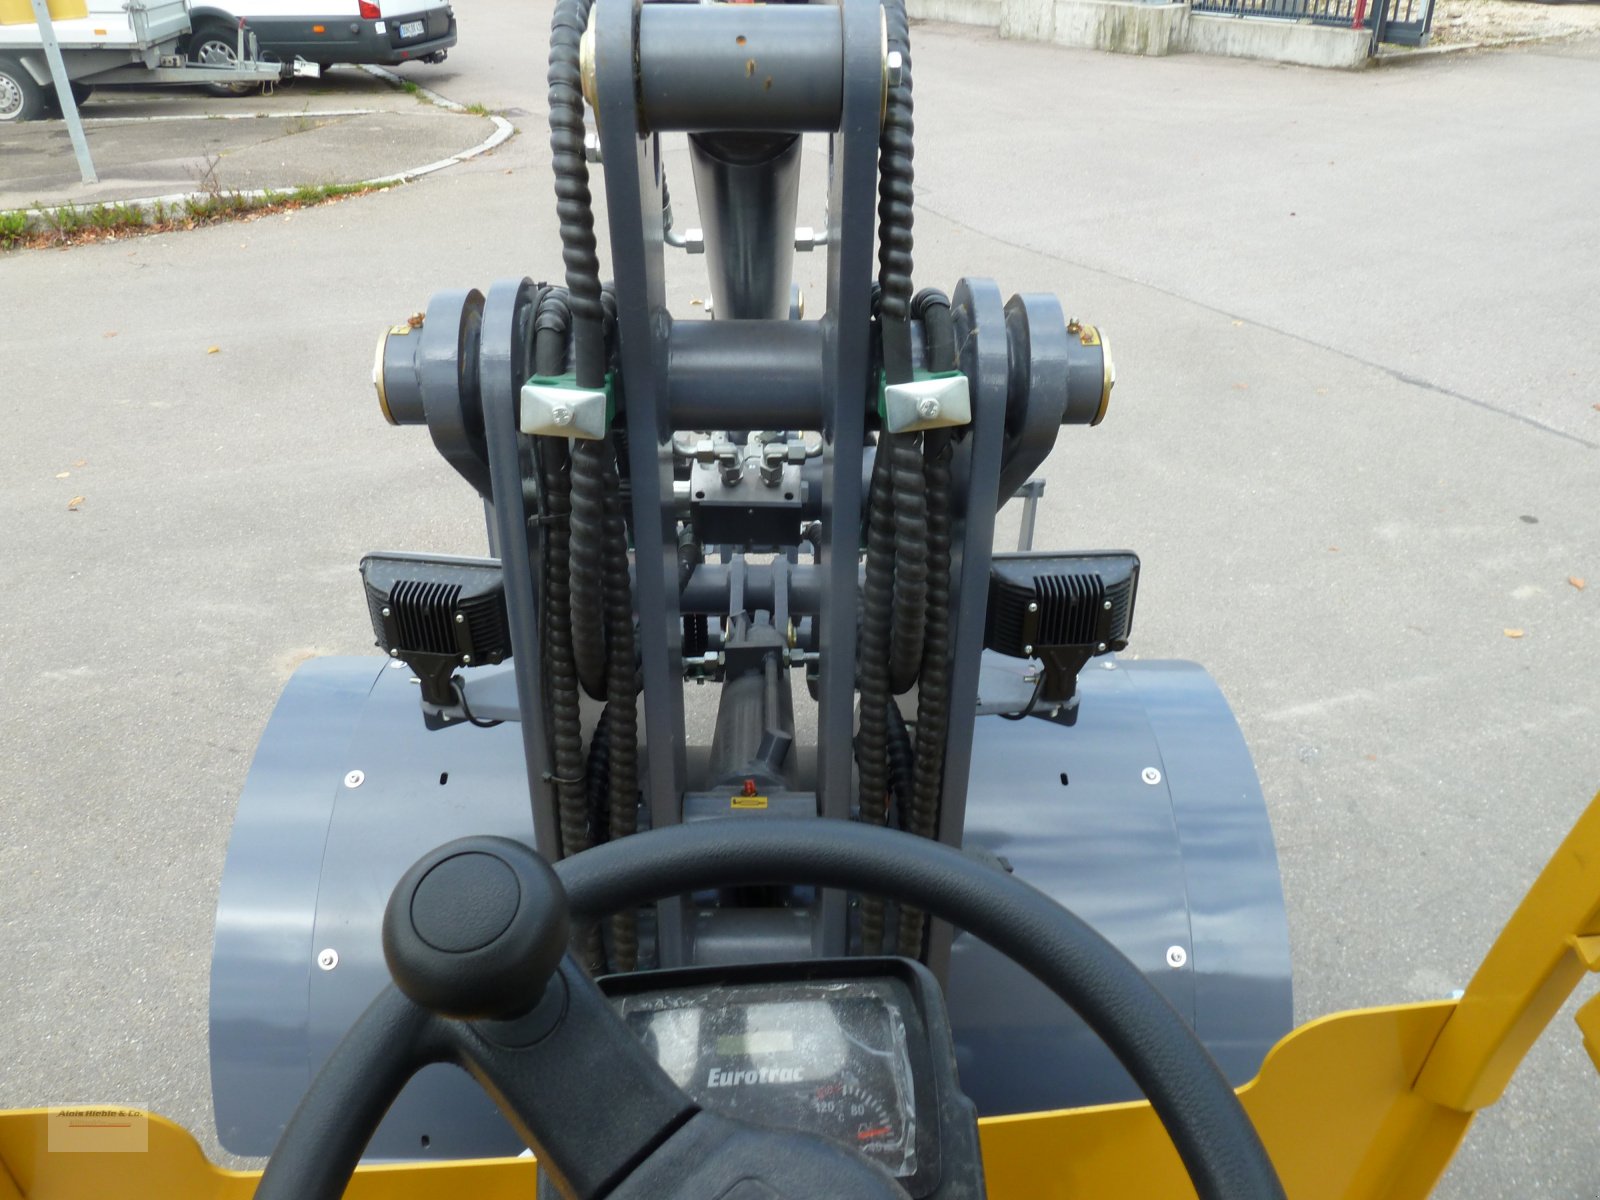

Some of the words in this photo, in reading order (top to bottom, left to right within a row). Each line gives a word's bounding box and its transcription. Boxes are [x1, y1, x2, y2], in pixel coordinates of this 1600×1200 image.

[707, 1066, 804, 1088] Eurotrac
[816, 1101, 835, 1113] 120
[850, 1104, 864, 1116] 80
